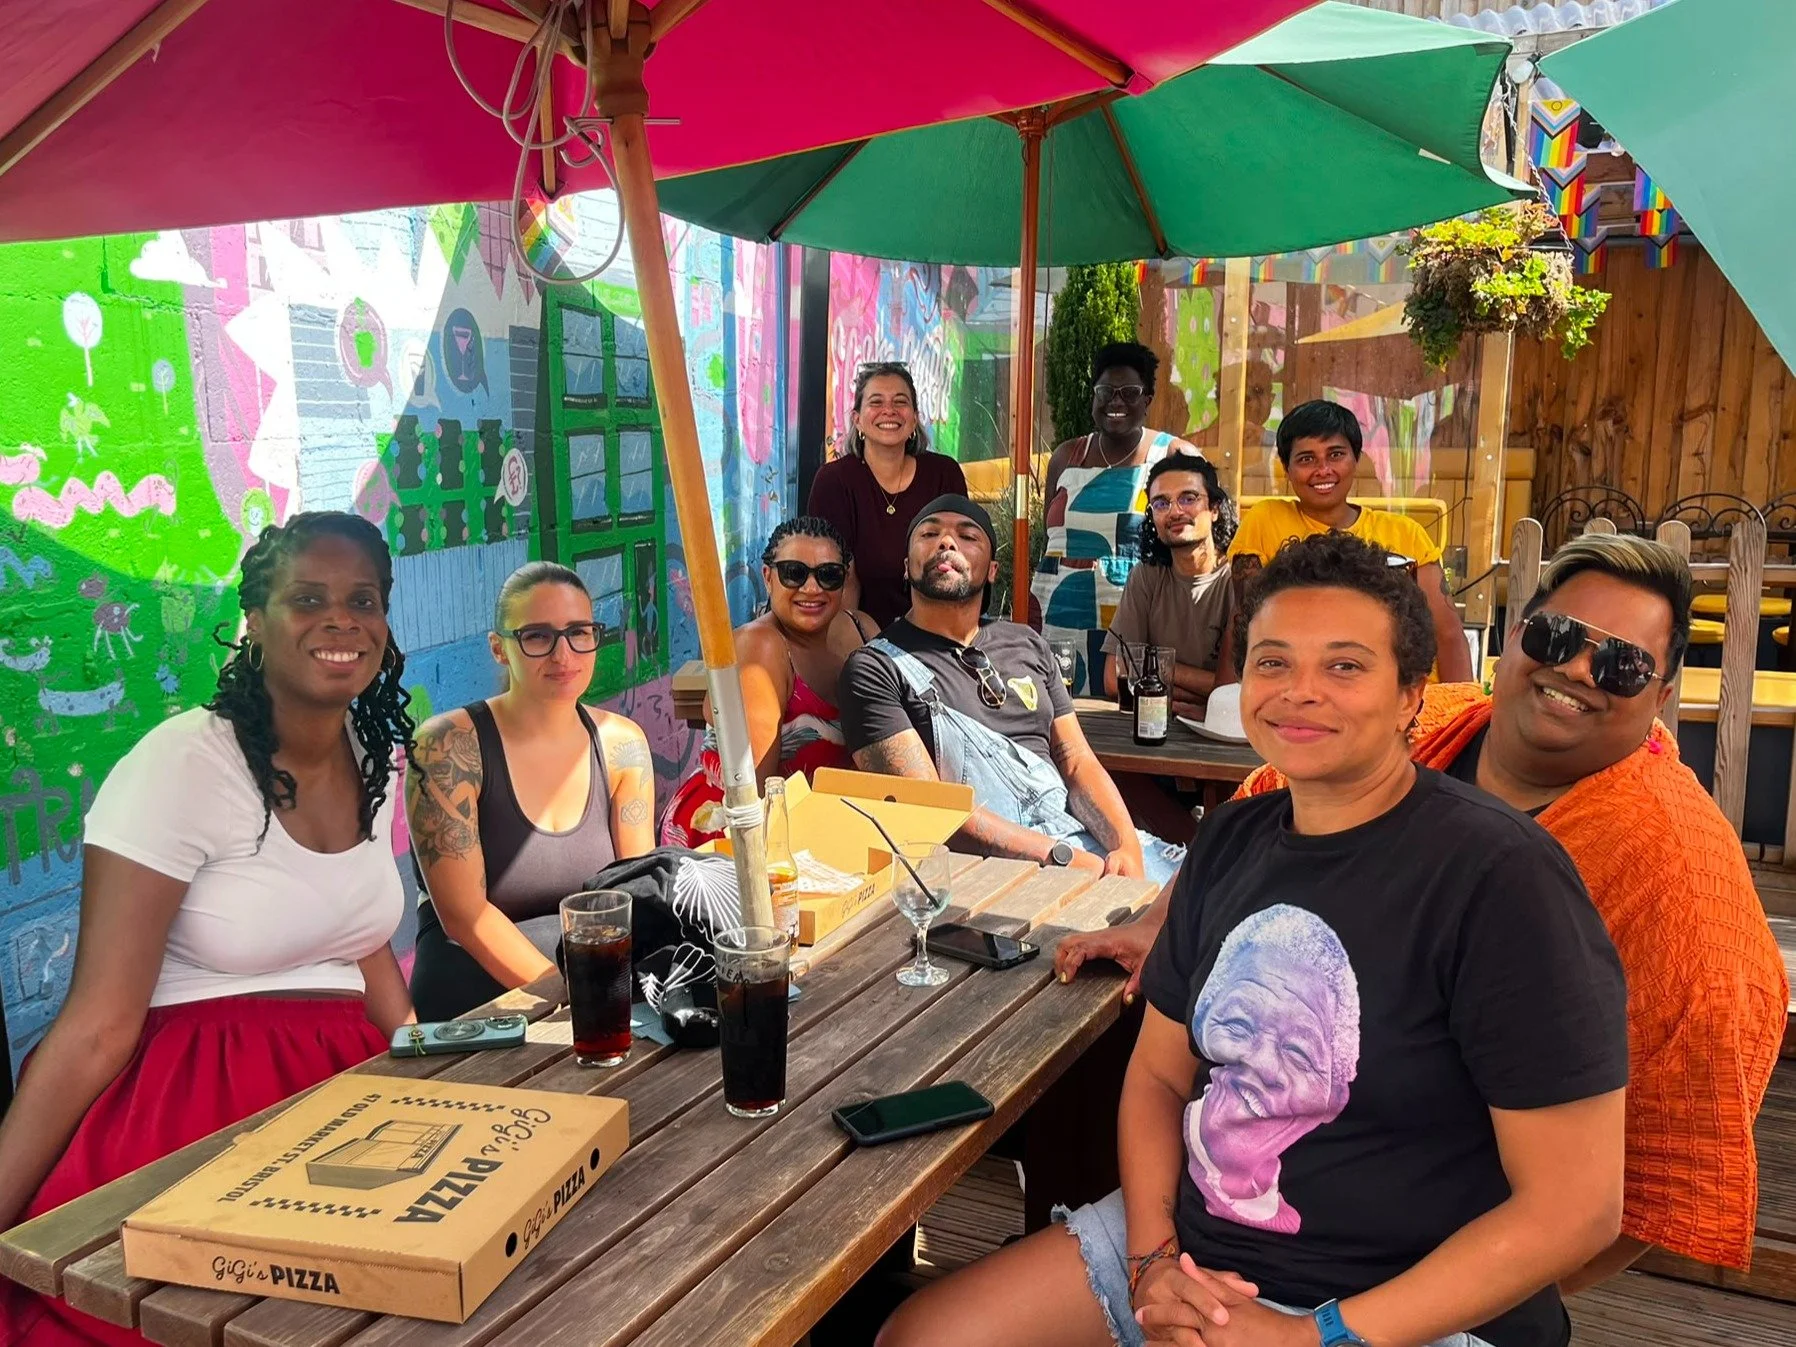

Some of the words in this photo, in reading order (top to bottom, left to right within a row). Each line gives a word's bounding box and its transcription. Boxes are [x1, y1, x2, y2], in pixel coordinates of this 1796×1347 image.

[341, 1103, 369, 1118] OLD
[292, 1118, 348, 1153] MARKET
[217, 1166, 281, 1202] BRISTOL
[392, 1157, 504, 1223] PIZZA
[553, 1165, 585, 1214] PIZZA
[270, 1264, 340, 1294] PIZZA
